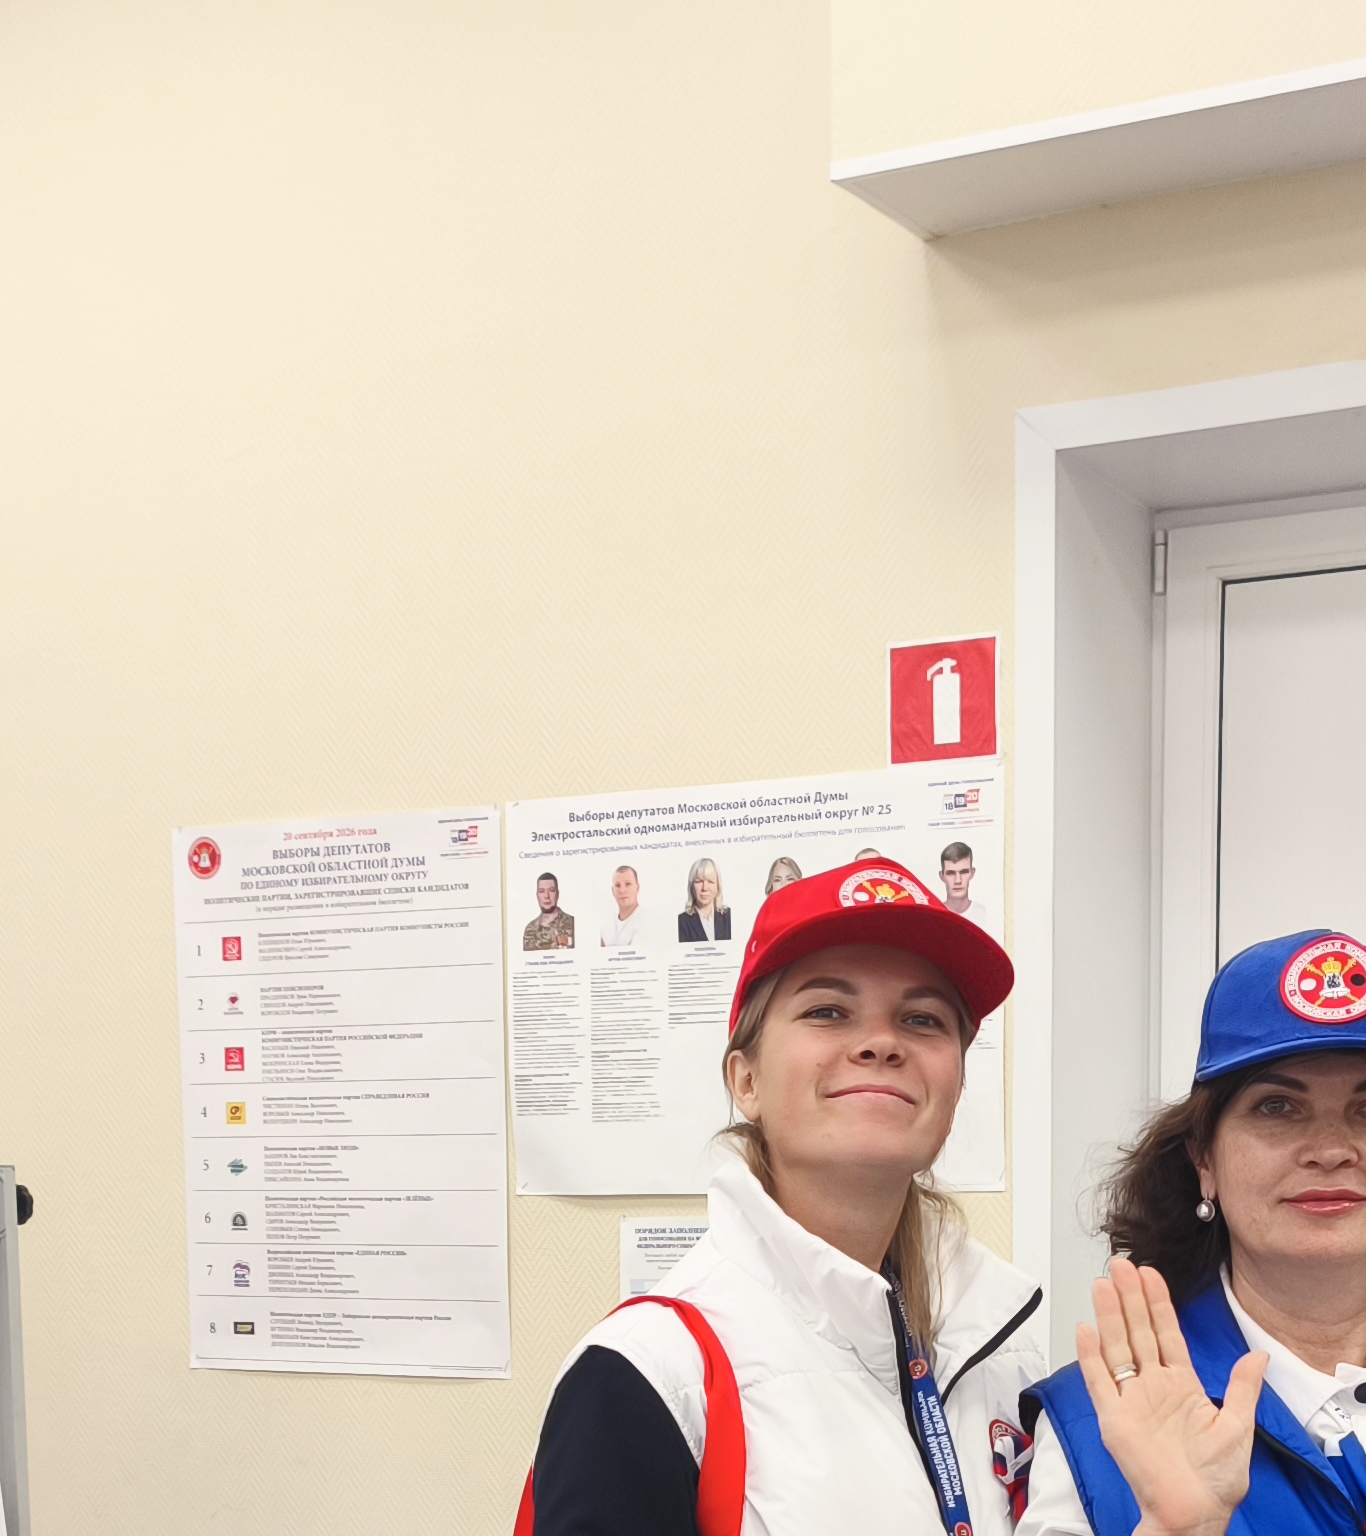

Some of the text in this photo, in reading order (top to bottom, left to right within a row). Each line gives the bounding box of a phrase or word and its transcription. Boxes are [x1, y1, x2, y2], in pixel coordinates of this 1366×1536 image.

[532, 804, 891, 842] Электростальский одномандатный избирательный округ № 25
[569, 792, 848, 822] Выборы депутатов Московской областной Думы
[242, 856, 425, 877] МОСКОВСКОЙ ОБЛАСТНОЙ ДУМЫ
[273, 843, 390, 859] ВЫБОРЫ ДЕПУТАТОВ
[927, 1395, 962, 1496] МОСКОВСКОЙ ОБЛАСТИ
[927, 1436, 955, 1508] ИЗБИРАТЕЛЬНАЯ
